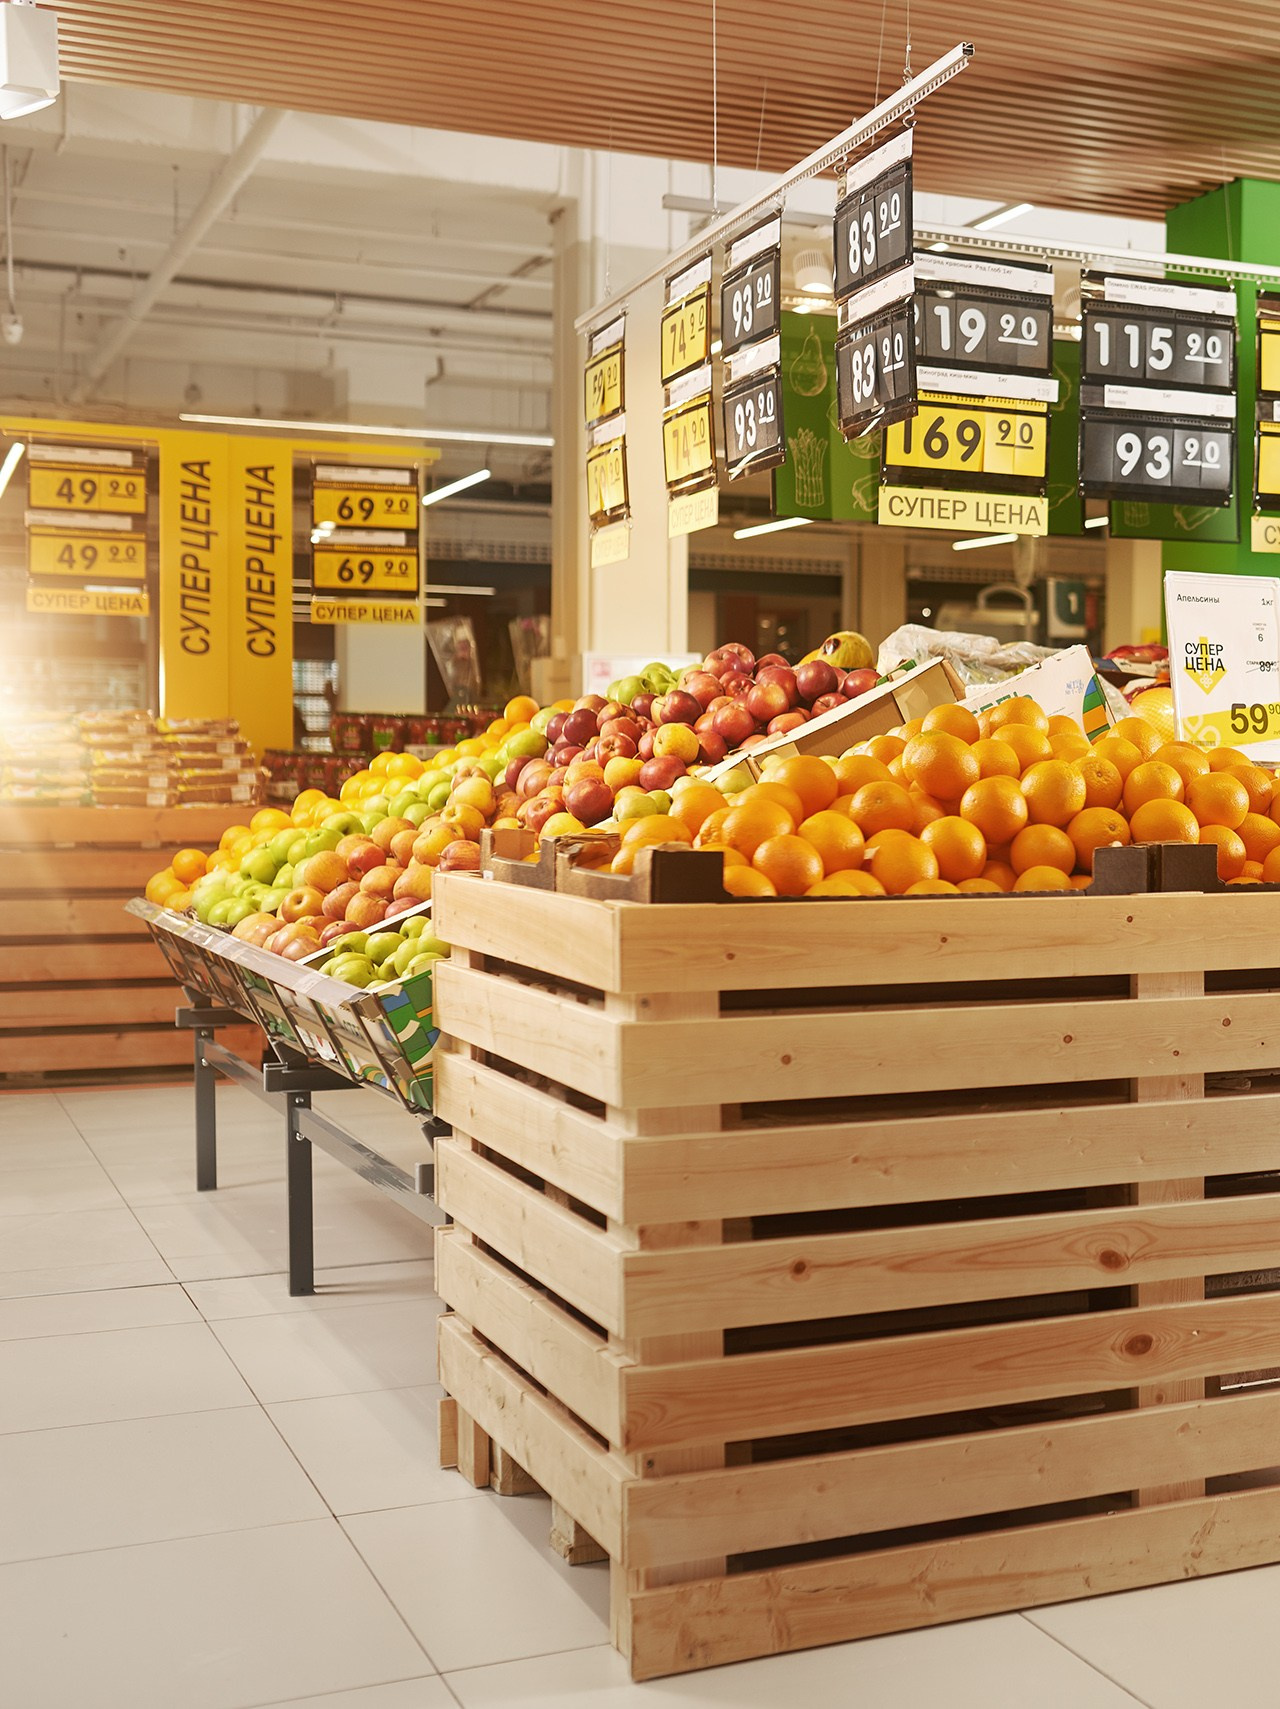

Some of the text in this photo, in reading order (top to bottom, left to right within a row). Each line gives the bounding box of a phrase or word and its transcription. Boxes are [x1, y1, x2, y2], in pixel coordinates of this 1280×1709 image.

[849, 210, 876, 274] 83
[879, 192, 901, 234] 90
[732, 273, 772, 338] 93 90
[670, 319, 687, 366] 74
[689, 304, 705, 333] 90
[914, 303, 1038, 354] 19 90
[1093, 322, 1222, 371] 115 90
[852, 332, 904, 403] 83 90
[734, 389, 775, 450] 93 90
[672, 417, 706, 471] 74 90
[903, 415, 1034, 463] 169 90
[1116, 432, 1220, 480] 93 90
[55, 477, 137, 505] 49 90
[336, 496, 410, 522] 69 90
[888, 495, 1041, 527] СУПЕР ЦЕНА
[57, 543, 137, 570] 49 90
[337, 558, 409, 584] 69 90
[32, 592, 144, 612] СУПЕР ЦЕНА
[316, 605, 416, 623] СУПЕР ЦЕНА
[1176, 593, 1273, 606] Апельсины 1кг
[1185, 642, 1224, 656] СУПЕР
[1257, 633, 1264, 643] 6
[1185, 657, 1226, 673] ЦЕНА
[1231, 703, 1269, 735] 59
